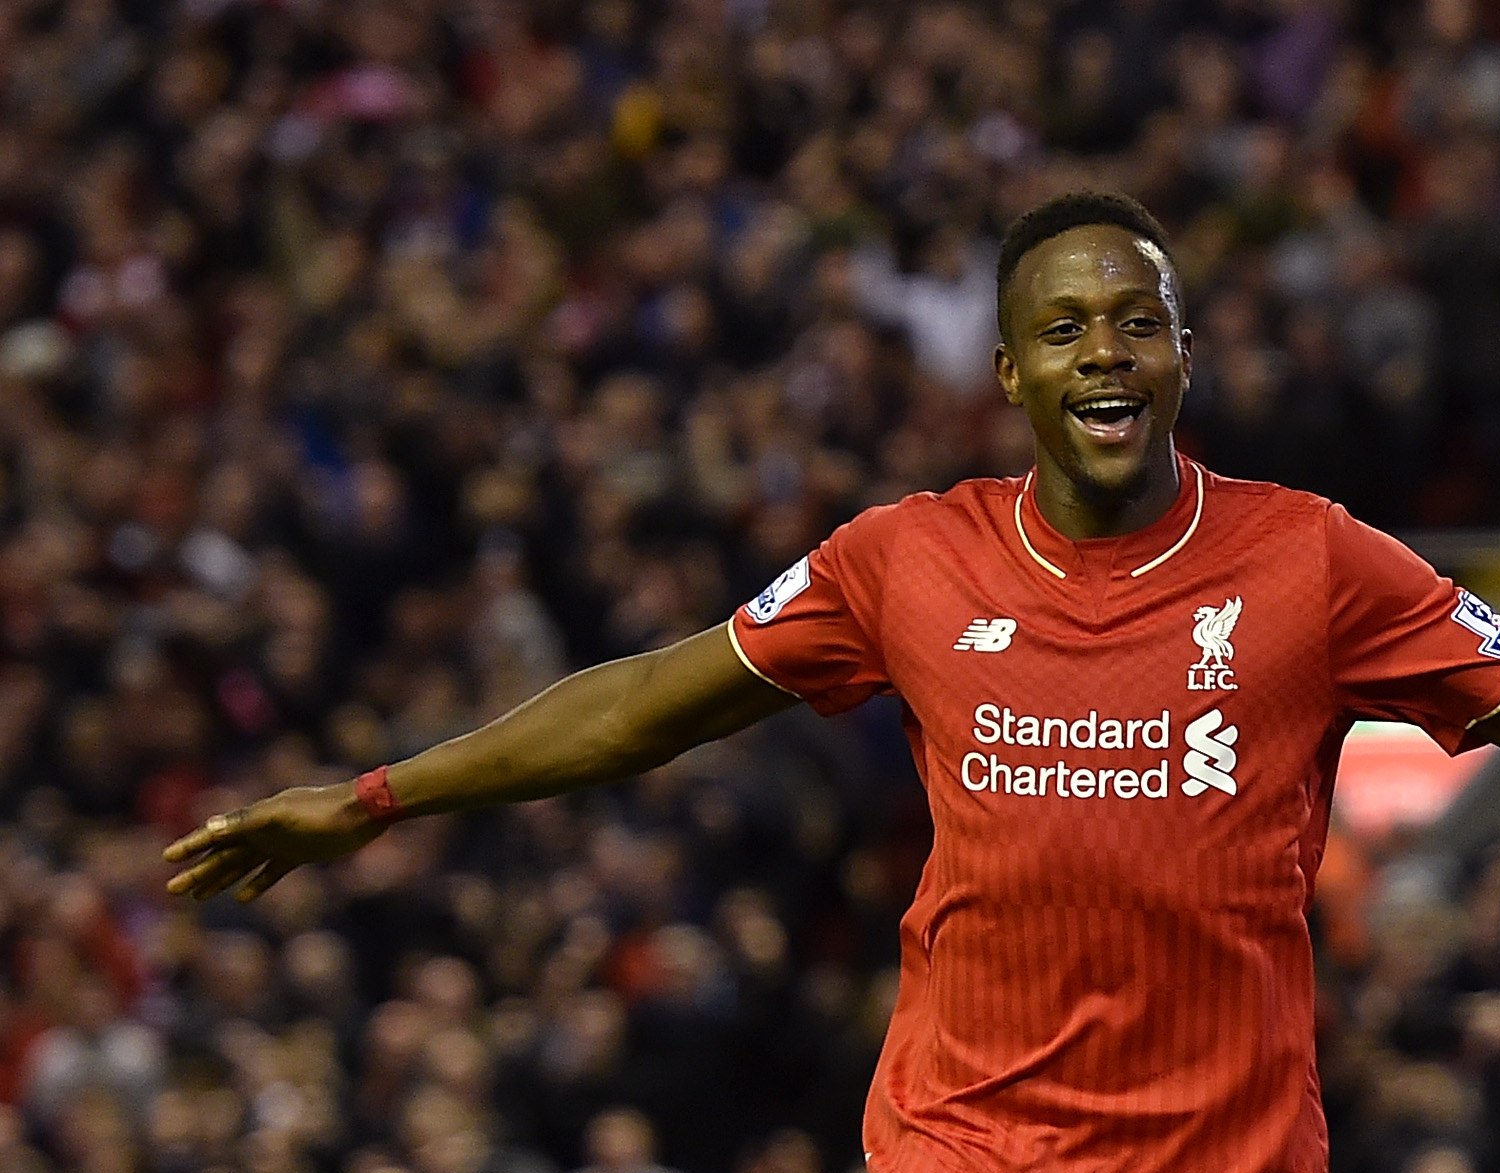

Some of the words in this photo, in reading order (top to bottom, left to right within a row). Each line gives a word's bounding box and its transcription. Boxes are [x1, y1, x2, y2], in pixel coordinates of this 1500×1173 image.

[1187, 670, 1238, 690] L.F.C.
[973, 703, 1169, 749] Standard
[961, 751, 1168, 799] Chartered
